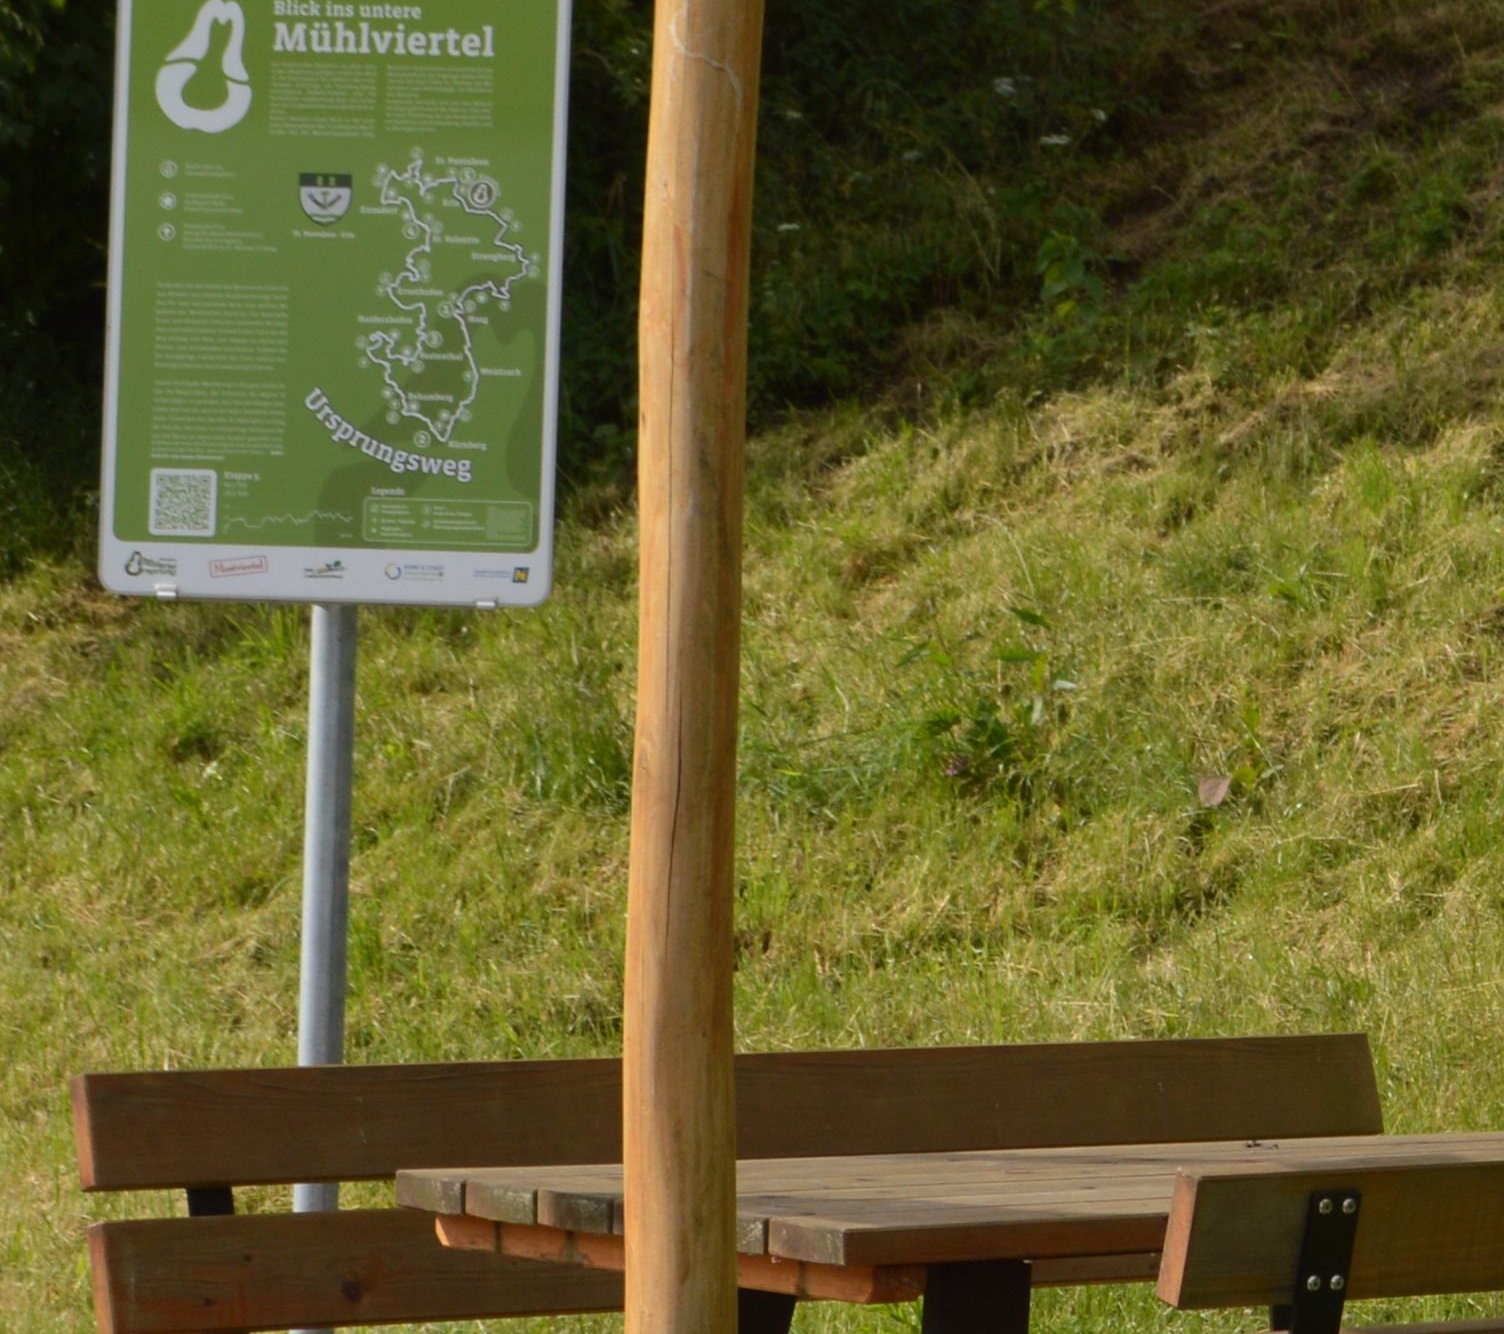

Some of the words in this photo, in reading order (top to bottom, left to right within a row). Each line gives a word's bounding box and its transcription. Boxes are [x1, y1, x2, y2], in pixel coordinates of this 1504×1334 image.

[273, 0, 321, 16] Blick
[326, 1, 355, 17] ins
[359, 4, 422, 20] untere
[273, 22, 495, 58] Mühlviertel
[305, 387, 472, 482] Ursprungsweg
